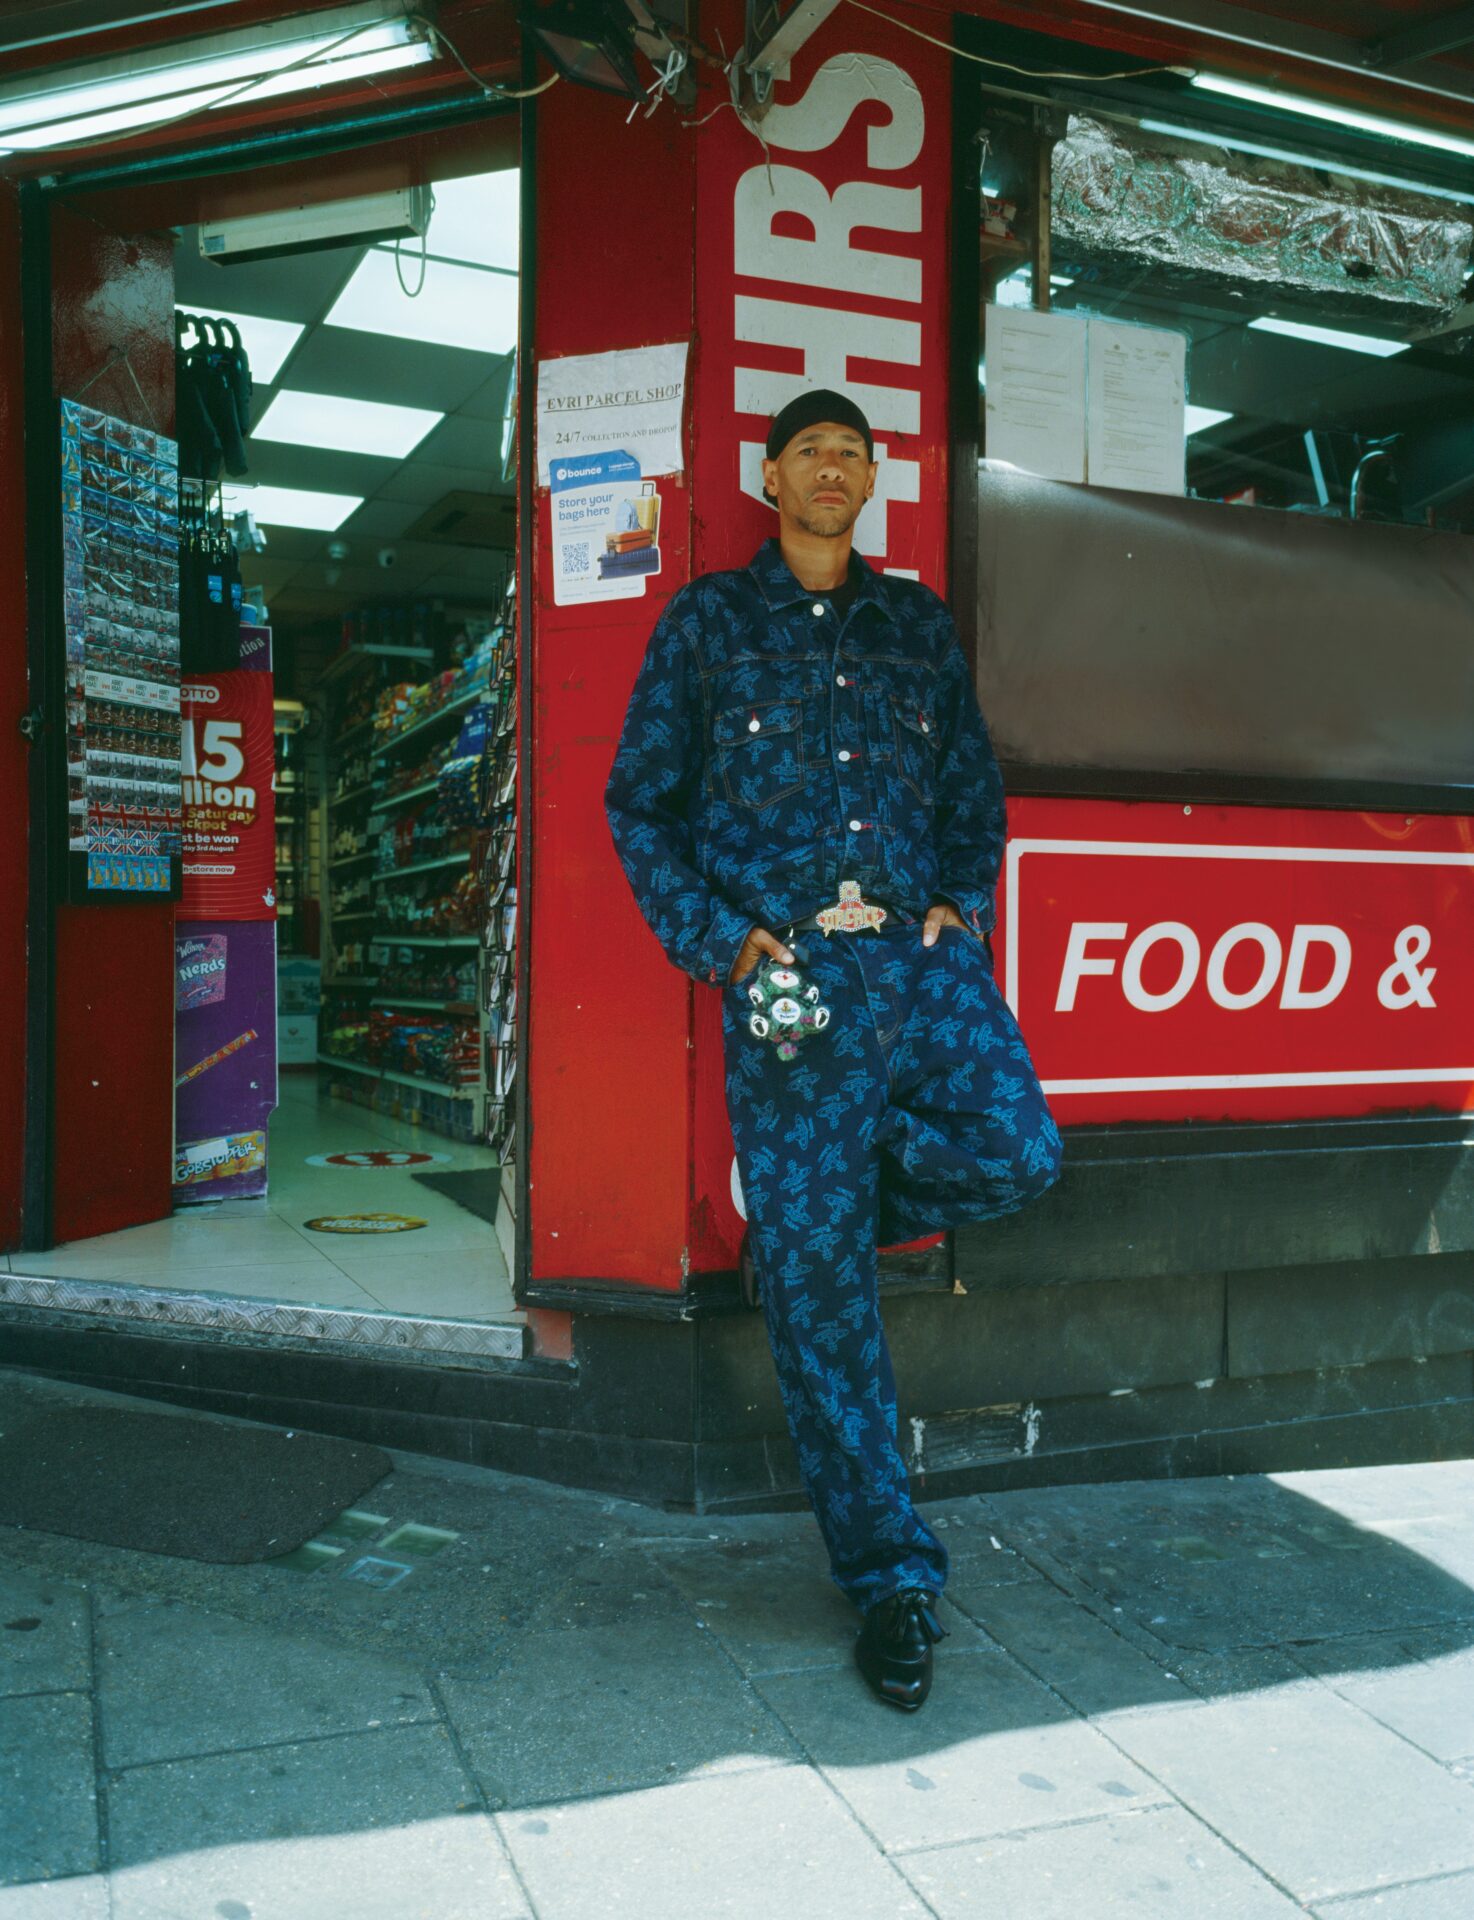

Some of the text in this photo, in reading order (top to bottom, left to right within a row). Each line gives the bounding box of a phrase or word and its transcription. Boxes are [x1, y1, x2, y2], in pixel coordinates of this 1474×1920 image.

[731, 50, 926, 584] 4HRS
[547, 383, 682, 410] EVRI PARCEL SHOP
[555, 431, 581, 445] 24/7
[582, 431, 630, 442] COLLECTION
[631, 429, 647, 439] AND
[567, 466, 602, 478] bounce
[558, 493, 614, 509] Store your
[558, 506, 610, 522] bags here
[188, 807, 256, 825] Saturday
[195, 833, 210, 843] be
[212, 835, 240, 844] won
[196, 844, 208, 852] 3rd
[209, 845, 234, 853] August
[215, 865, 234, 873] now
[1054, 921, 1438, 1013] FOOD &
